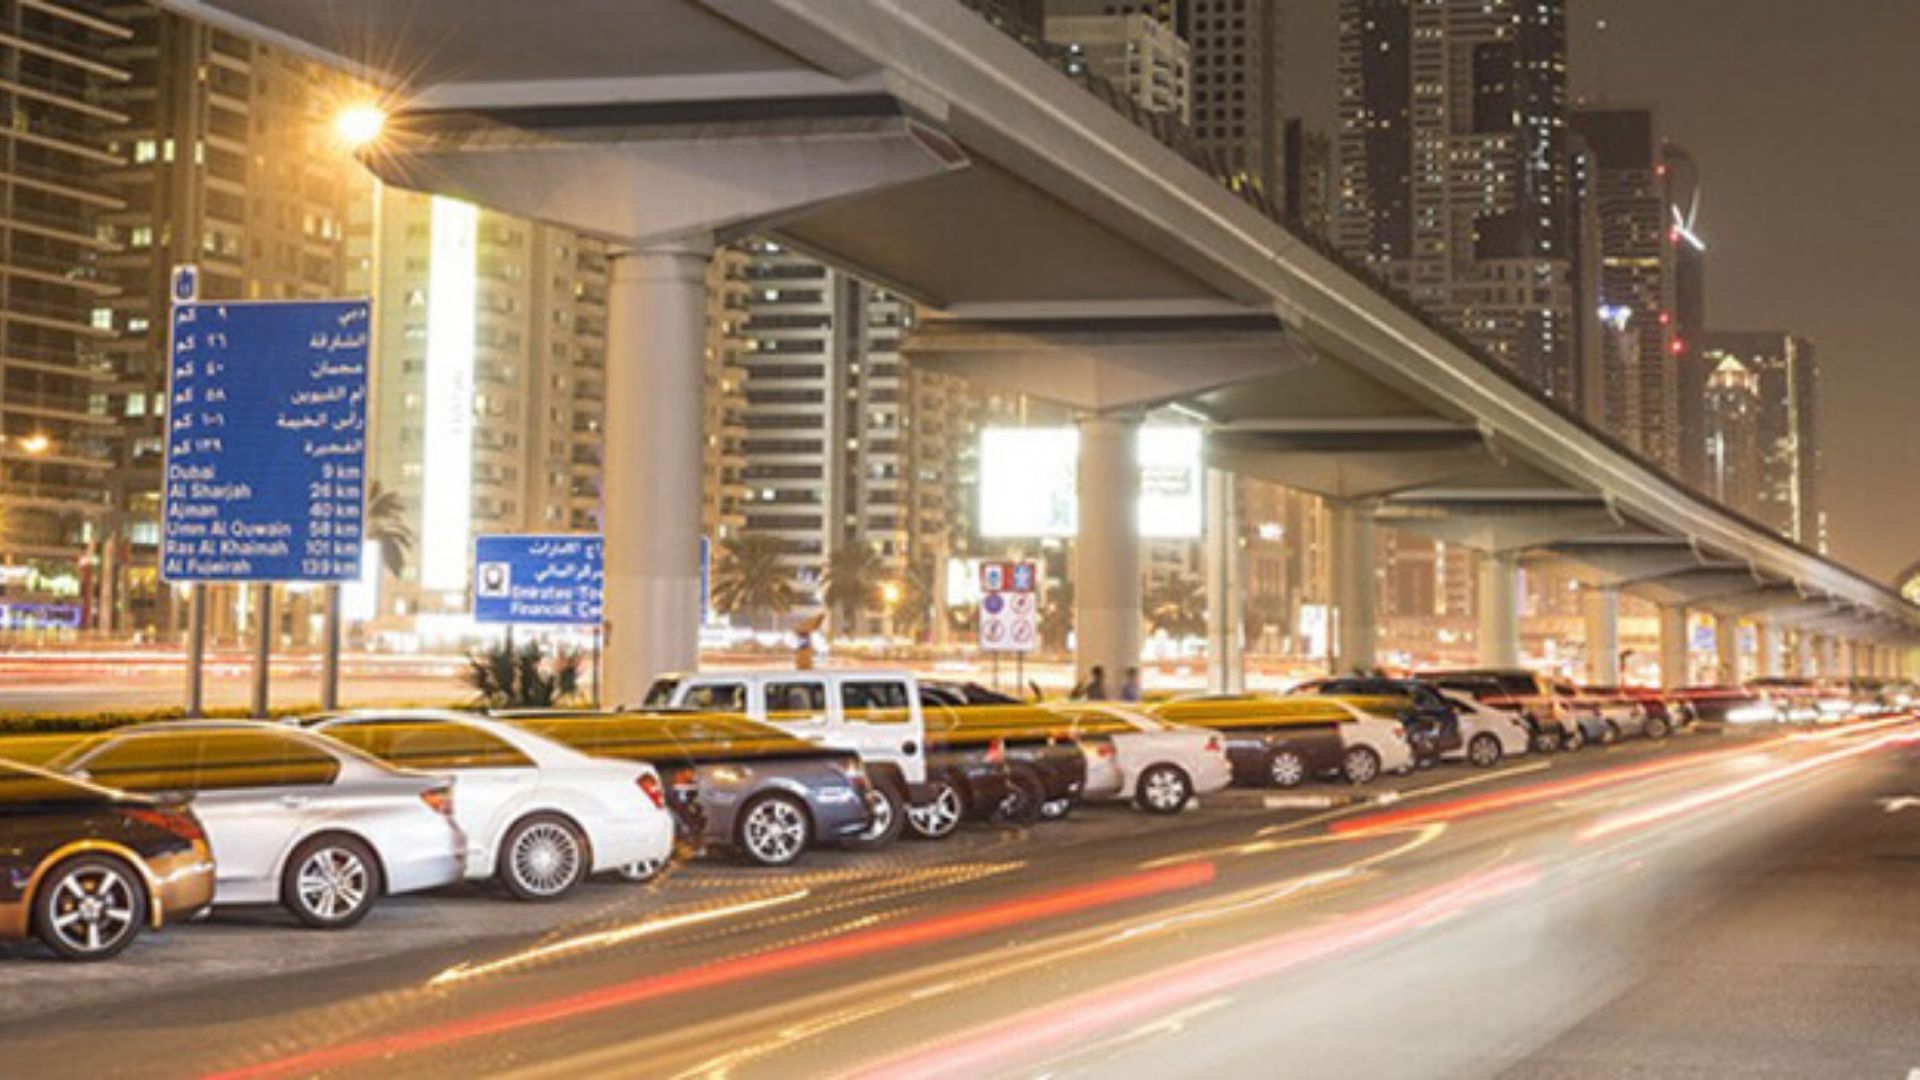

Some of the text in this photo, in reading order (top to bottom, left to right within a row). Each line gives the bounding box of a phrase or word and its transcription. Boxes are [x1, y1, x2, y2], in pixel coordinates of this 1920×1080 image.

[170, 463, 360, 480] Dubai 9 km
[170, 481, 360, 502] Al Sharjah 26 km
[170, 501, 360, 520] Ajman 40 km
[230, 519, 292, 538] Quwain
[334, 520, 359, 537] km
[166, 539, 196, 555] Ras
[198, 539, 217, 554] Al
[333, 539, 358, 556] km
[165, 557, 183, 573] Al
[333, 558, 358, 575] km
[511, 585, 573, 601] Emirates
[509, 601, 572, 618] Financial
